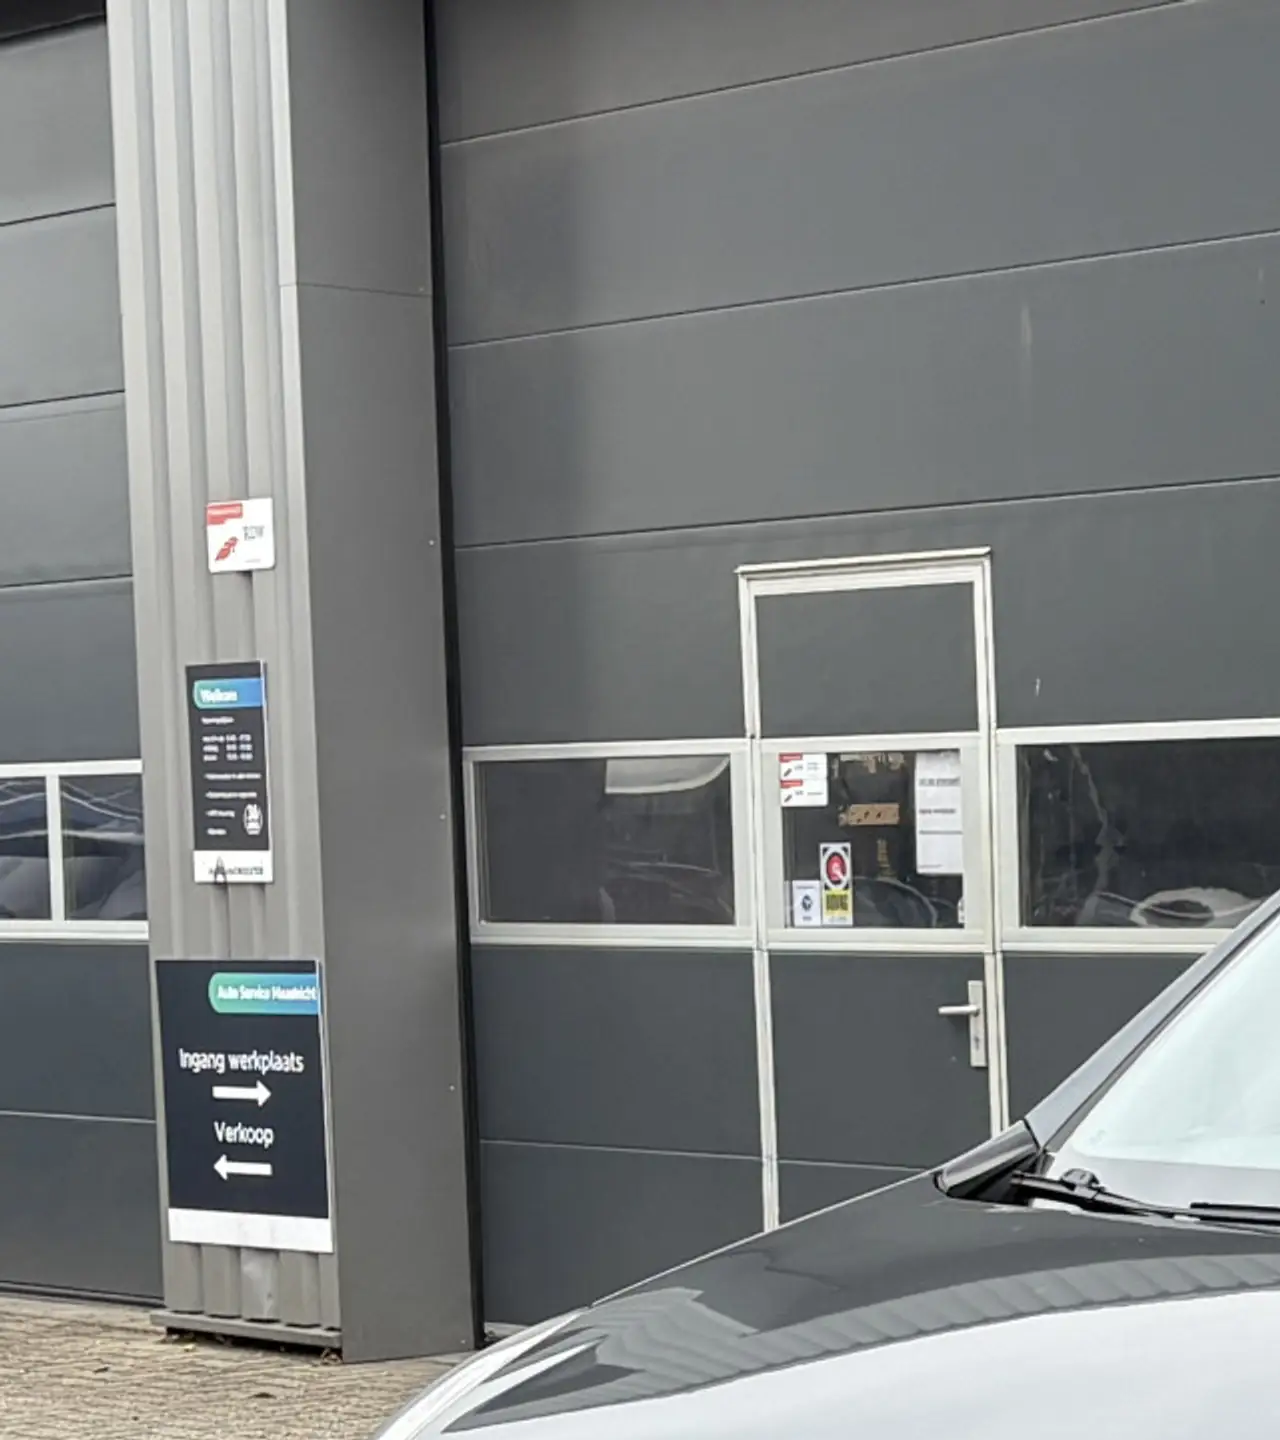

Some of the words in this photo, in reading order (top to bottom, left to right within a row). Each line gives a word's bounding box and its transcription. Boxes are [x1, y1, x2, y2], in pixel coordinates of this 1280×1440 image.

[179, 1048, 225, 1074] Ingang
[228, 1049, 304, 1076] werkplaats
[213, 1121, 275, 1149] Verkoop
